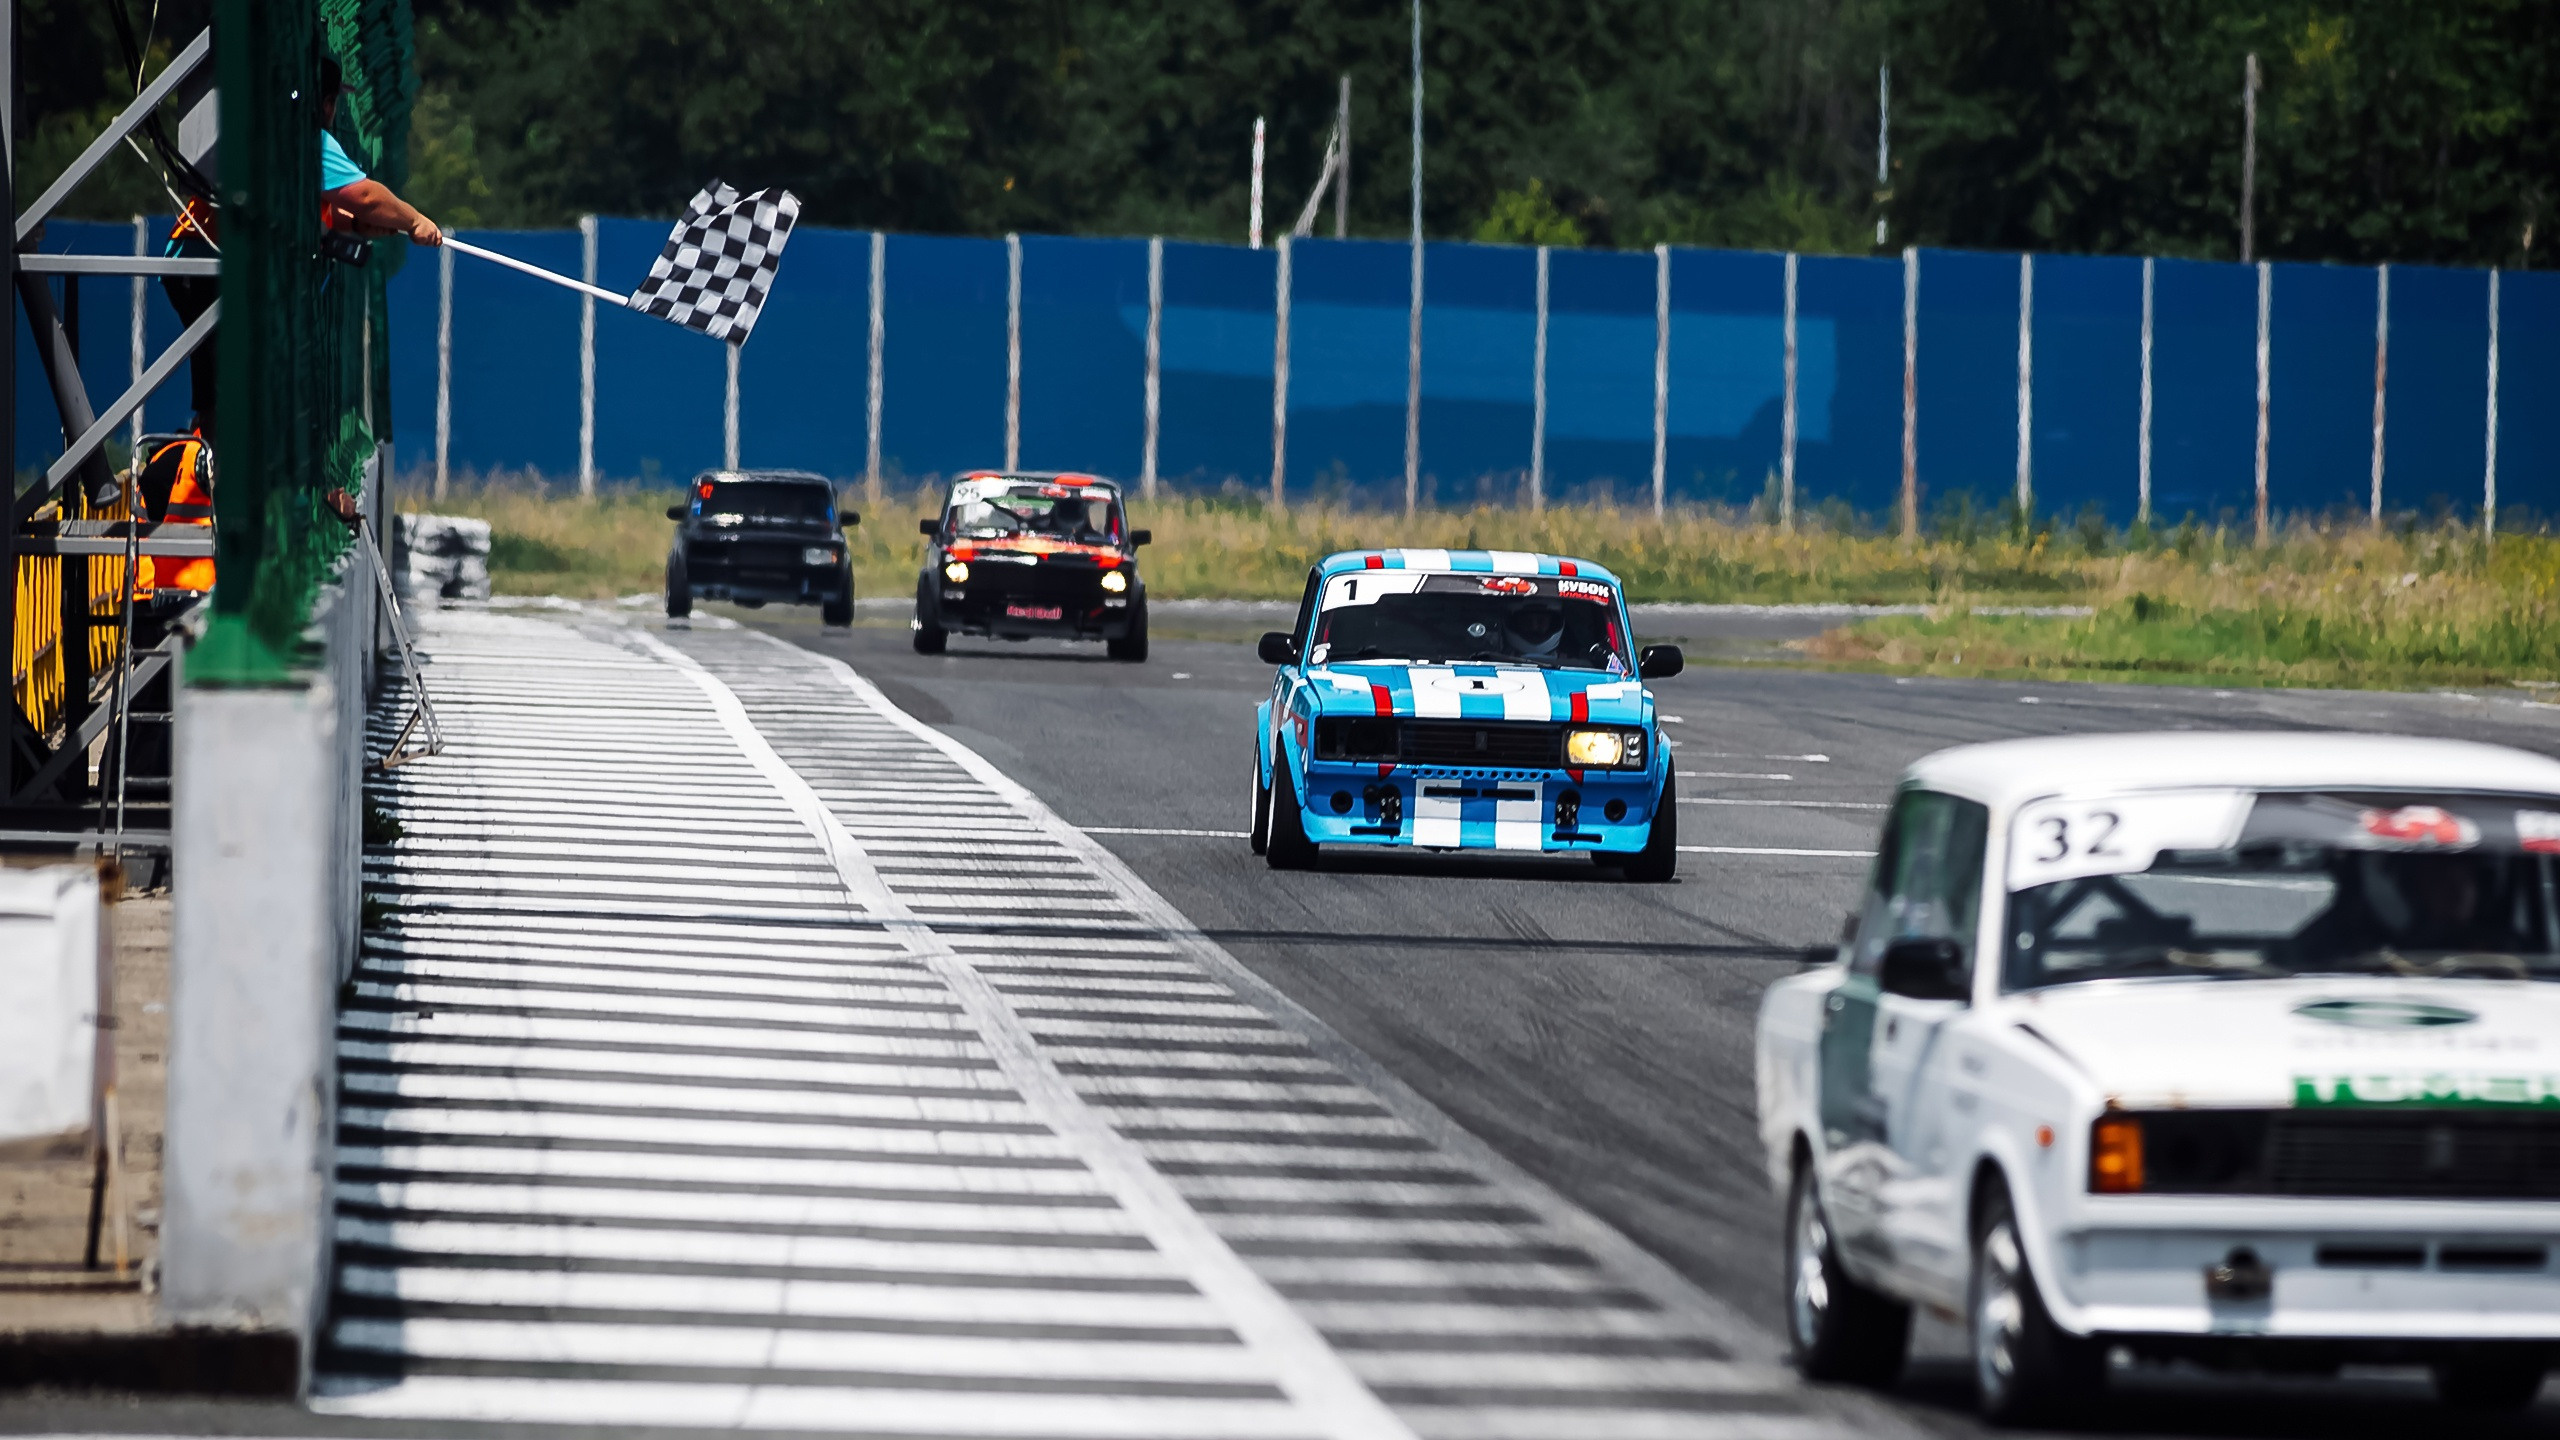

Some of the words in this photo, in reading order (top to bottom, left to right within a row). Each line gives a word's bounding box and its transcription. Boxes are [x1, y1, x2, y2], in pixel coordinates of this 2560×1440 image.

[957, 486, 980, 499] 95
[1344, 579, 1358, 601] 1
[1558, 579, 1610, 598] КУБОК
[2037, 811, 2123, 862] 32
